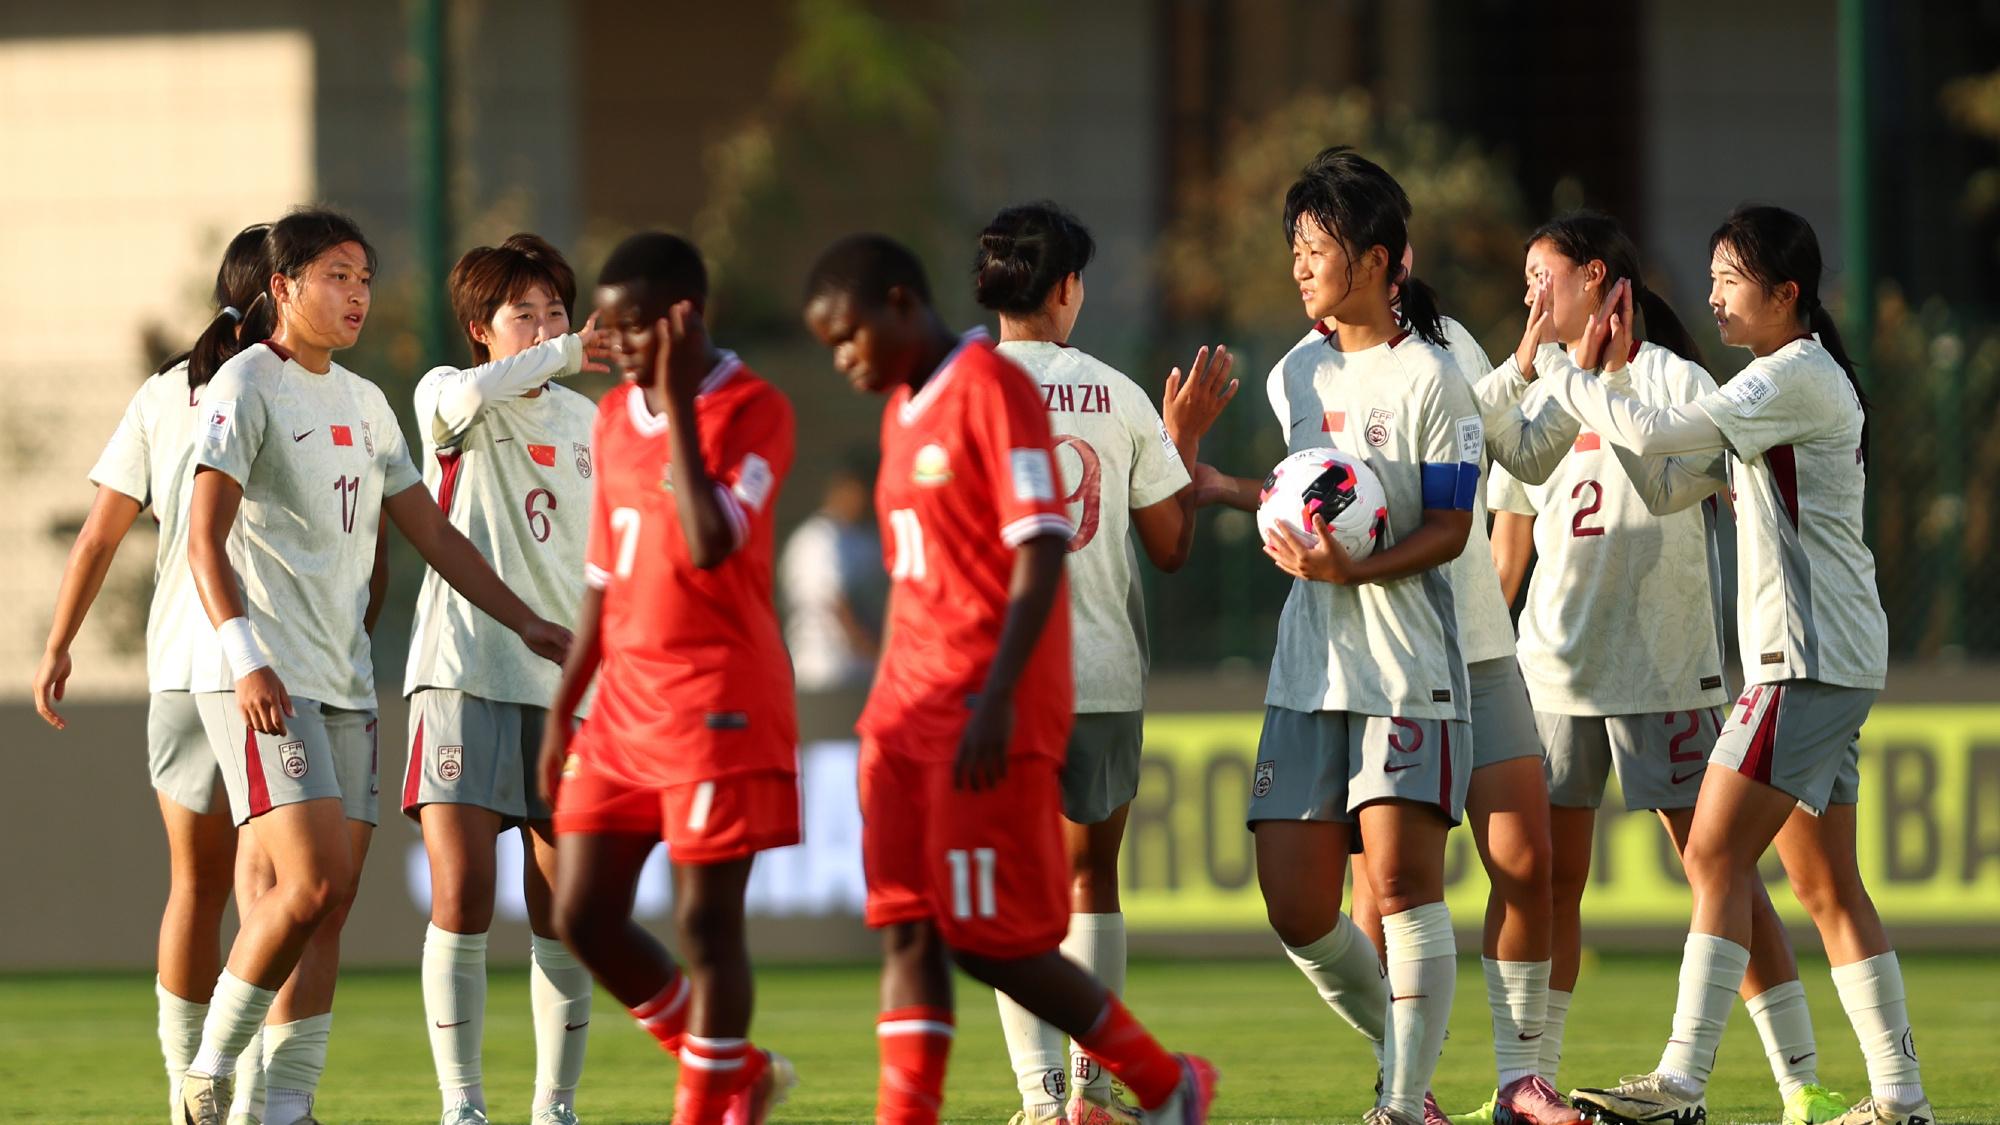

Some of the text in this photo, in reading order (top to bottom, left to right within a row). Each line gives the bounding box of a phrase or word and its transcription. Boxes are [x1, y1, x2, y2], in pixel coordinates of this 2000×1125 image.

[1078, 384, 1111, 413] ZH
[334, 474, 360, 534] 11
[525, 488, 557, 543] 6
[1571, 480, 1605, 537] 2
[611, 507, 640, 579] 7
[890, 508, 926, 581] 11
[1737, 686, 1763, 725] 4
[440, 747, 461, 755] CFA
[1664, 709, 1704, 764] 2
[947, 847, 997, 920] 11
